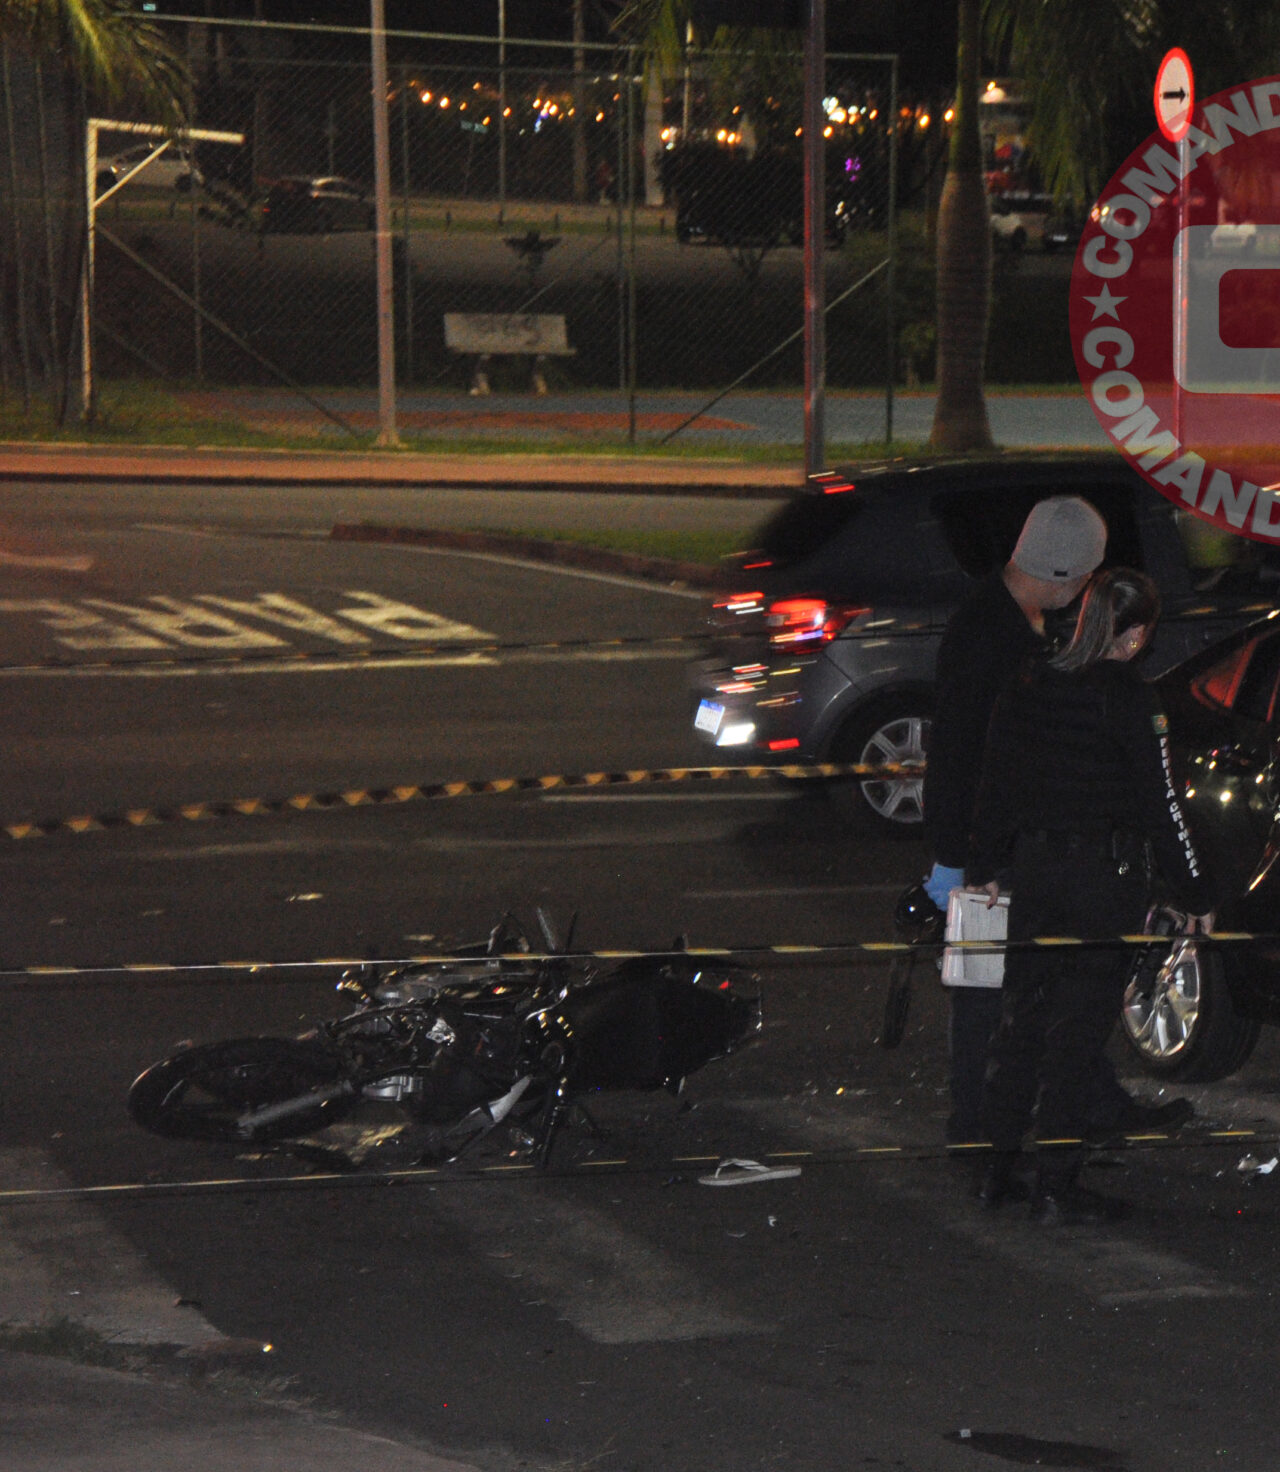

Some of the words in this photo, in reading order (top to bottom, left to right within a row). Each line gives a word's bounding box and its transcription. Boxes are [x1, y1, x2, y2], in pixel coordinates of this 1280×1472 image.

[0, 591, 499, 649] PARE
[1160, 736, 1176, 800] PERITA
[1168, 801, 1199, 878] CRIMINAL
